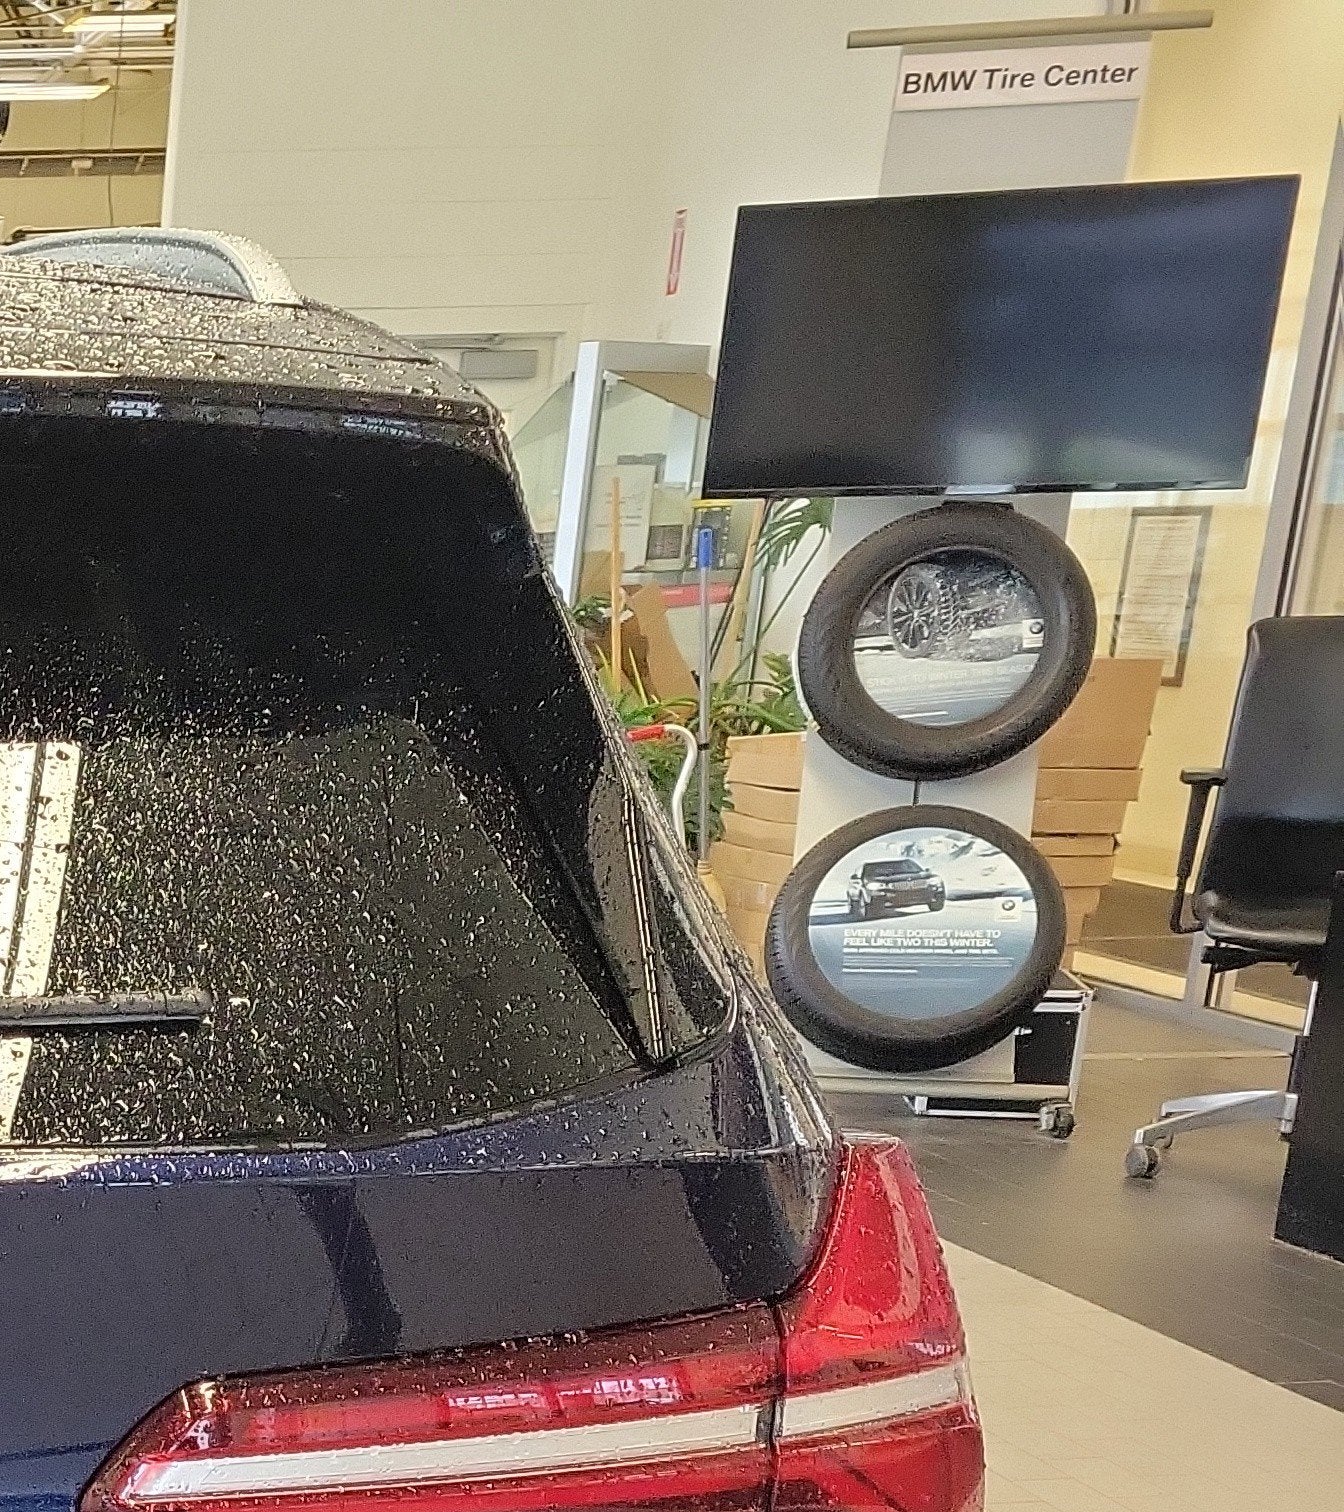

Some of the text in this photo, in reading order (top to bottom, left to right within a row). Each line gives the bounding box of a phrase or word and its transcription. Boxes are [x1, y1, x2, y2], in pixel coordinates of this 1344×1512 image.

[902, 64, 1139, 95] BMW Tire Center
[844, 928, 877, 937] EVERY
[879, 929, 904, 937] MILE
[955, 929, 983, 938] HAVE
[986, 929, 1002, 939] TO
[844, 937, 869, 946] FEEL
[871, 938, 894, 946] LIKE
[897, 938, 922, 946] TWO
[923, 938, 948, 947] THIS
